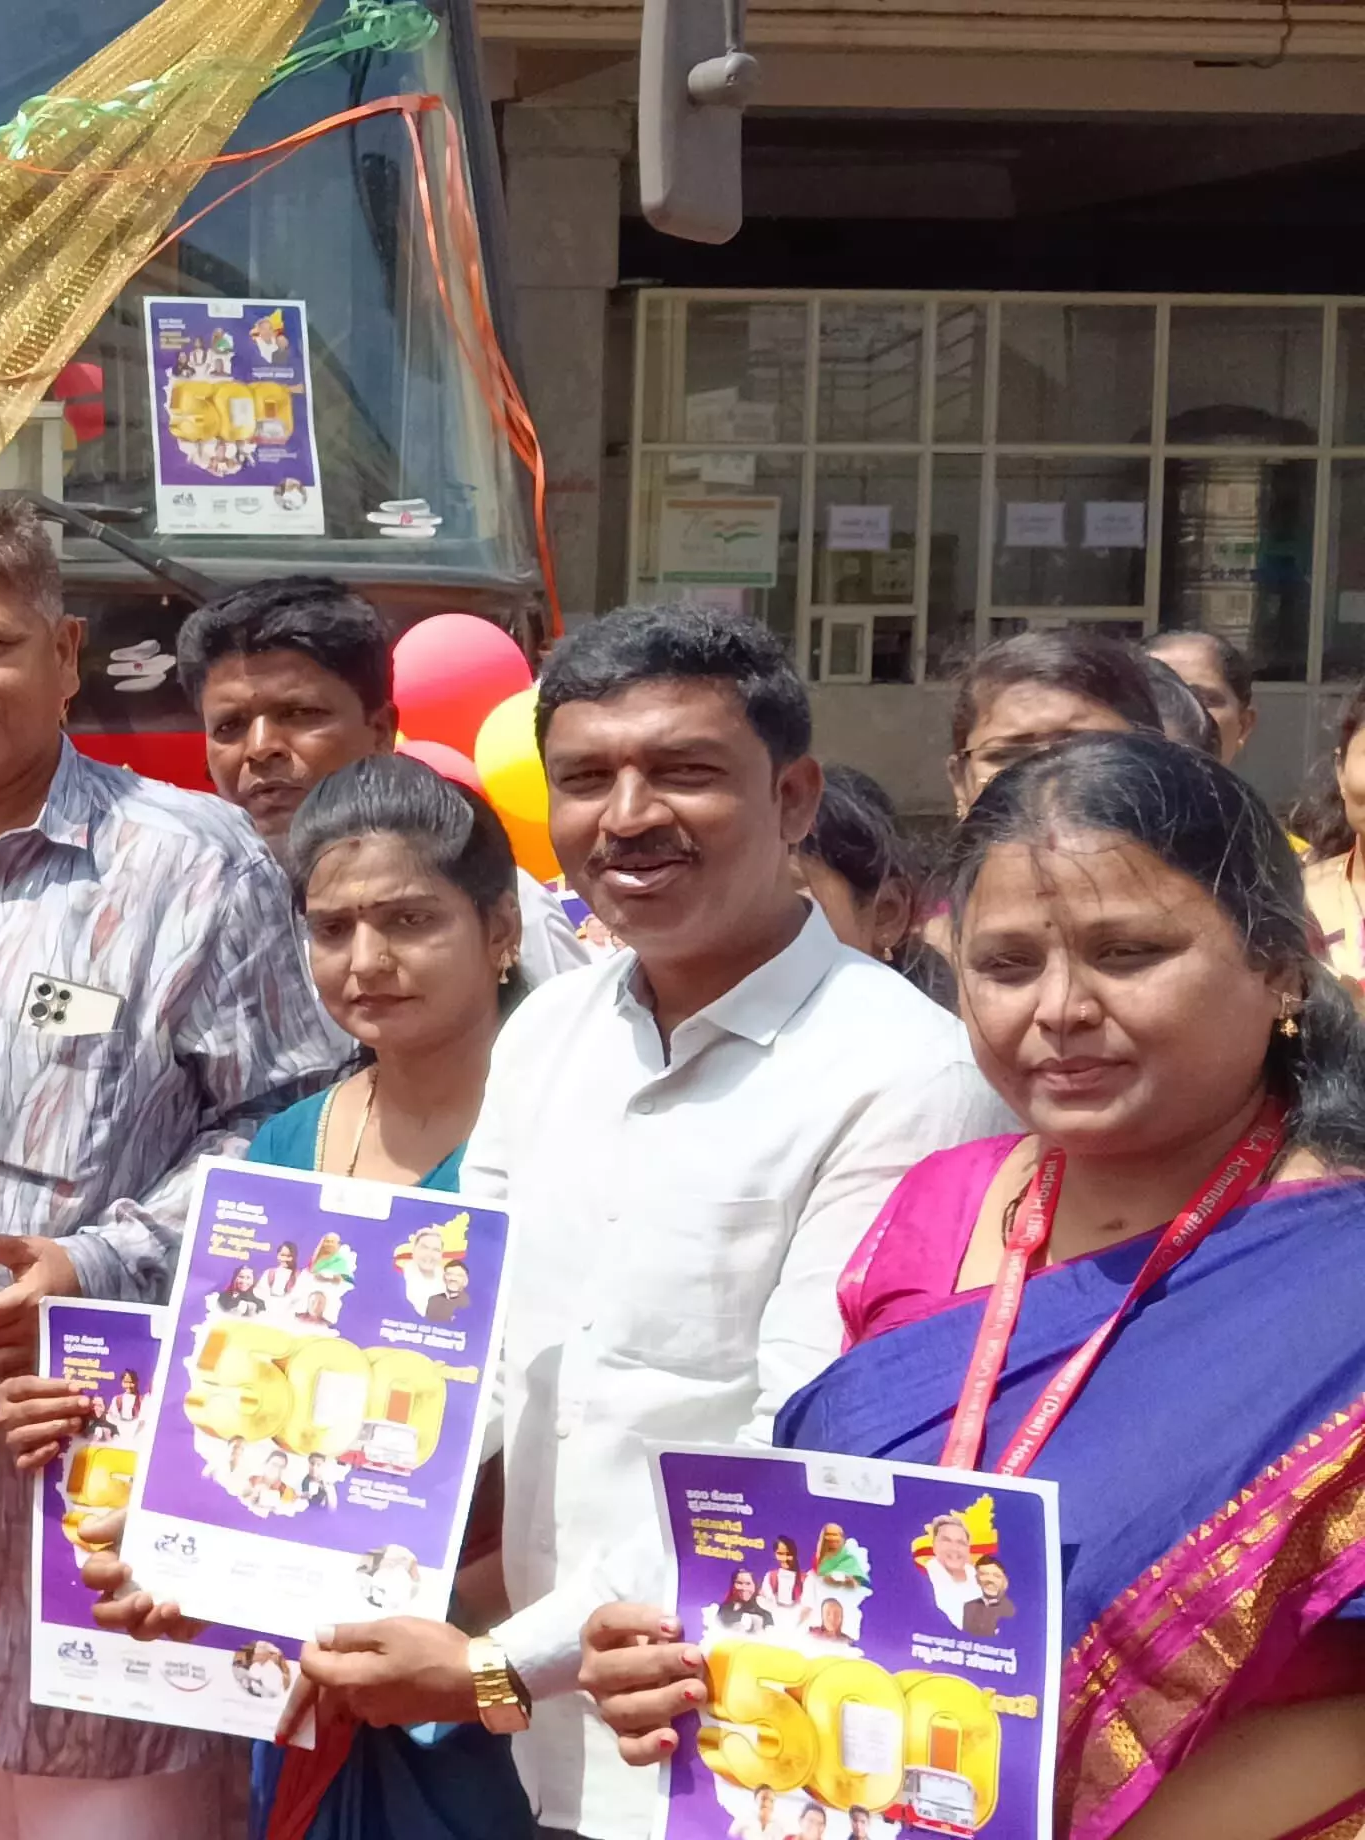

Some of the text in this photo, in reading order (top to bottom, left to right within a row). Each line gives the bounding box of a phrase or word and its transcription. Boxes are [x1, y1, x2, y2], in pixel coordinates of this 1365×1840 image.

[183, 1314, 447, 1473] 500
[1000, 1436, 1034, 1478] Hosp
[697, 1639, 1001, 1831] 500
